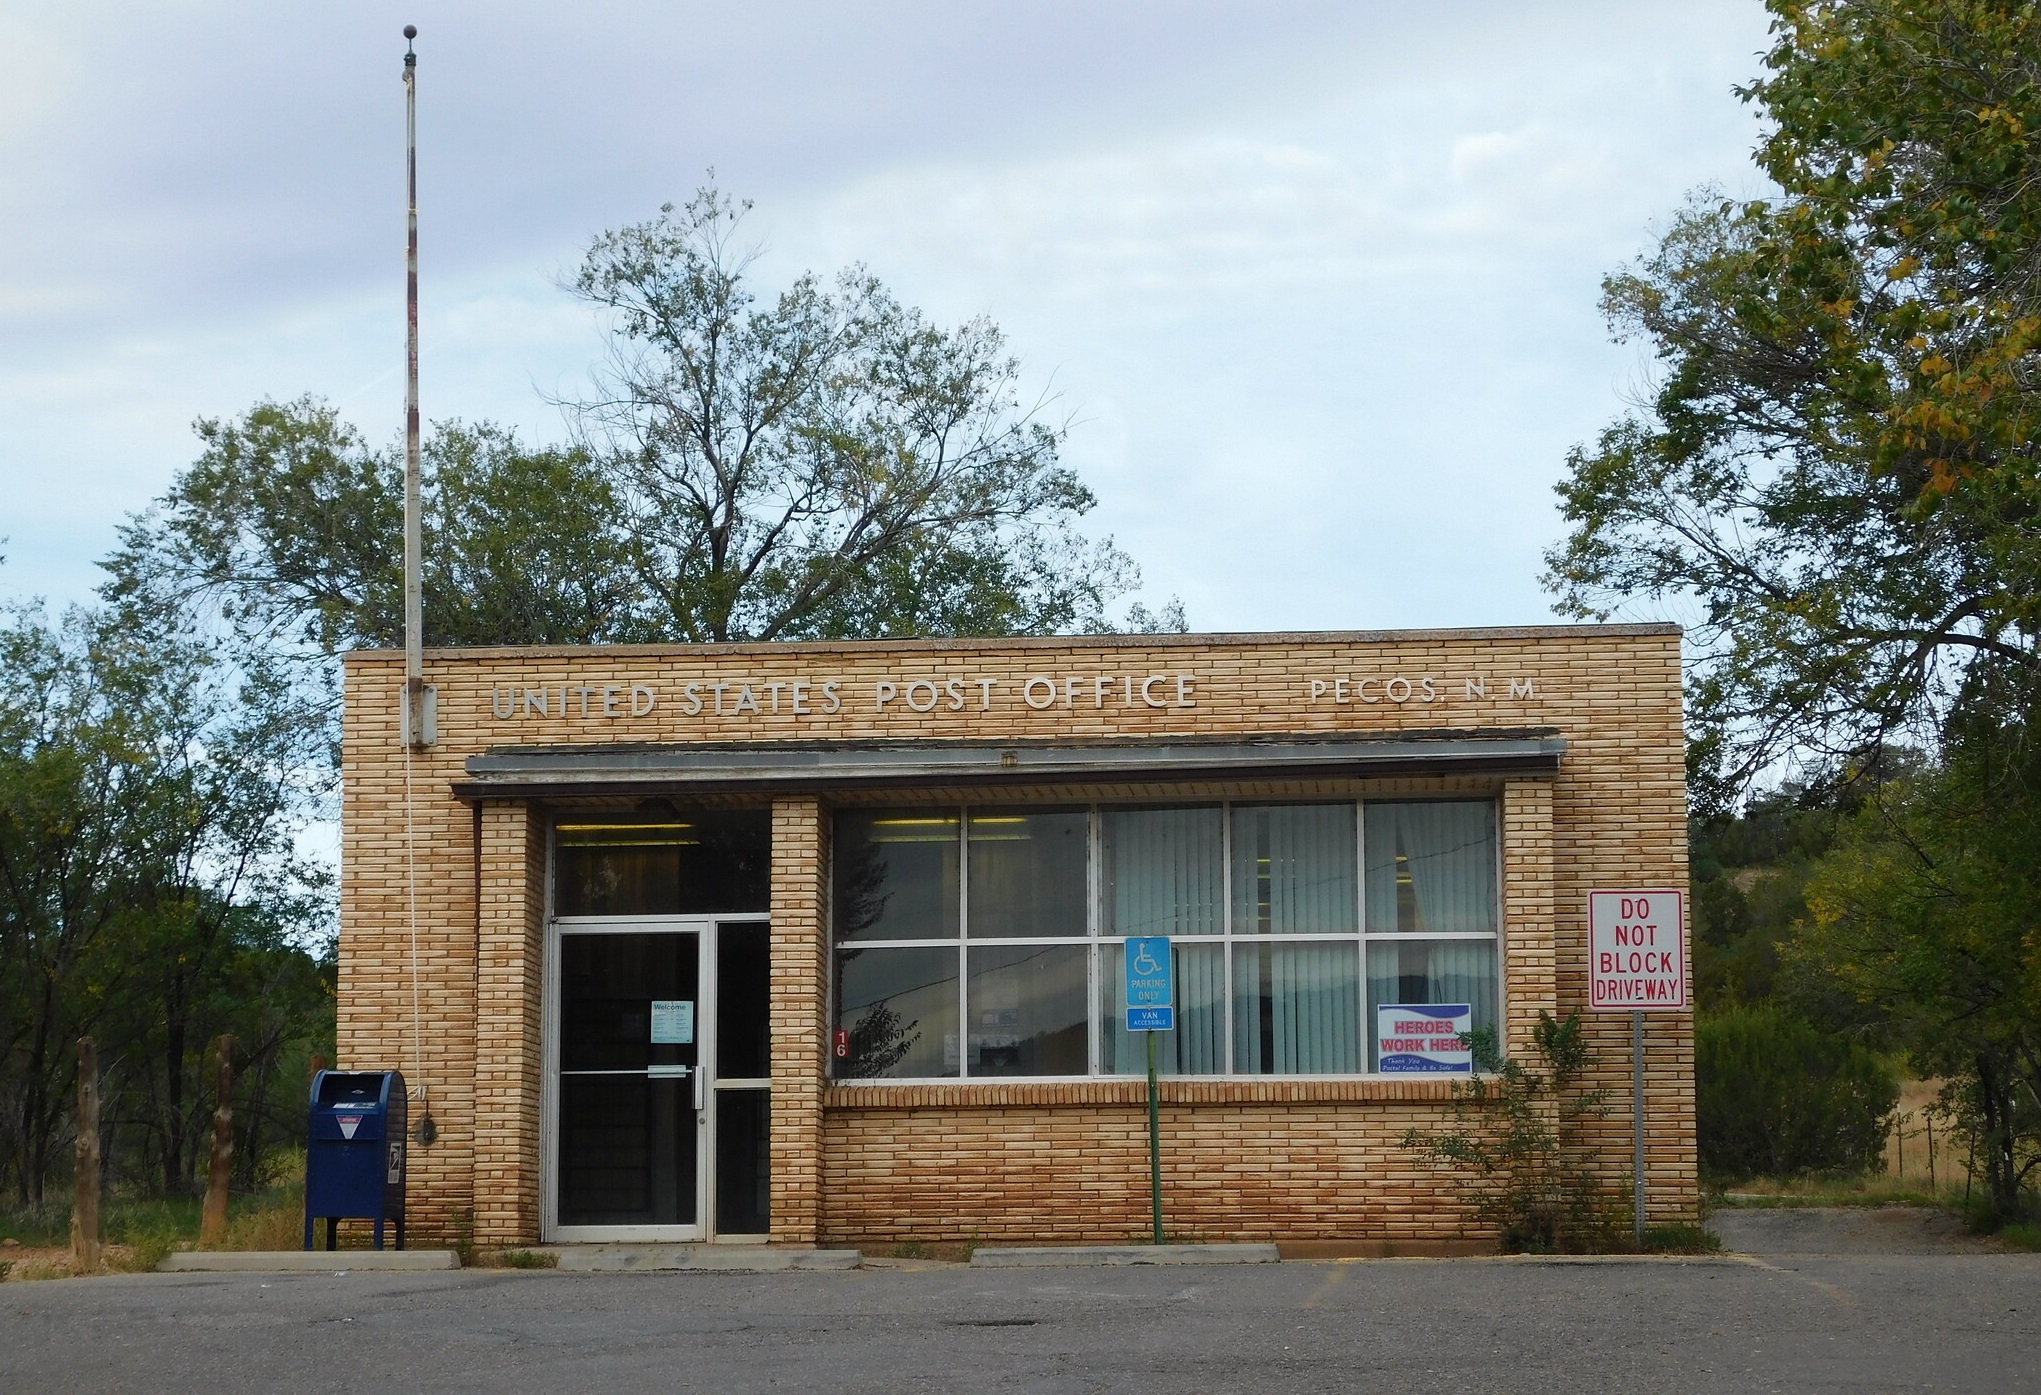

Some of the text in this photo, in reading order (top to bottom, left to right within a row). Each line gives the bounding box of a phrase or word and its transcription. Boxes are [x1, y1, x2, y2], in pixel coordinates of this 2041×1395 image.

[492, 674, 1197, 719] UNITED STATES POST OFFICE
[1621, 898, 1650, 919] DO
[1615, 925, 1657, 946] NOT
[1600, 952, 1673, 973] BLOCK
[1131, 979, 1166, 988] PARKING
[1596, 979, 1677, 1000] DRIVEWAY
[1138, 991, 1159, 1001] ONLY
[1394, 1021, 1455, 1034] HEROES
[1381, 1039, 1425, 1052] WORK
